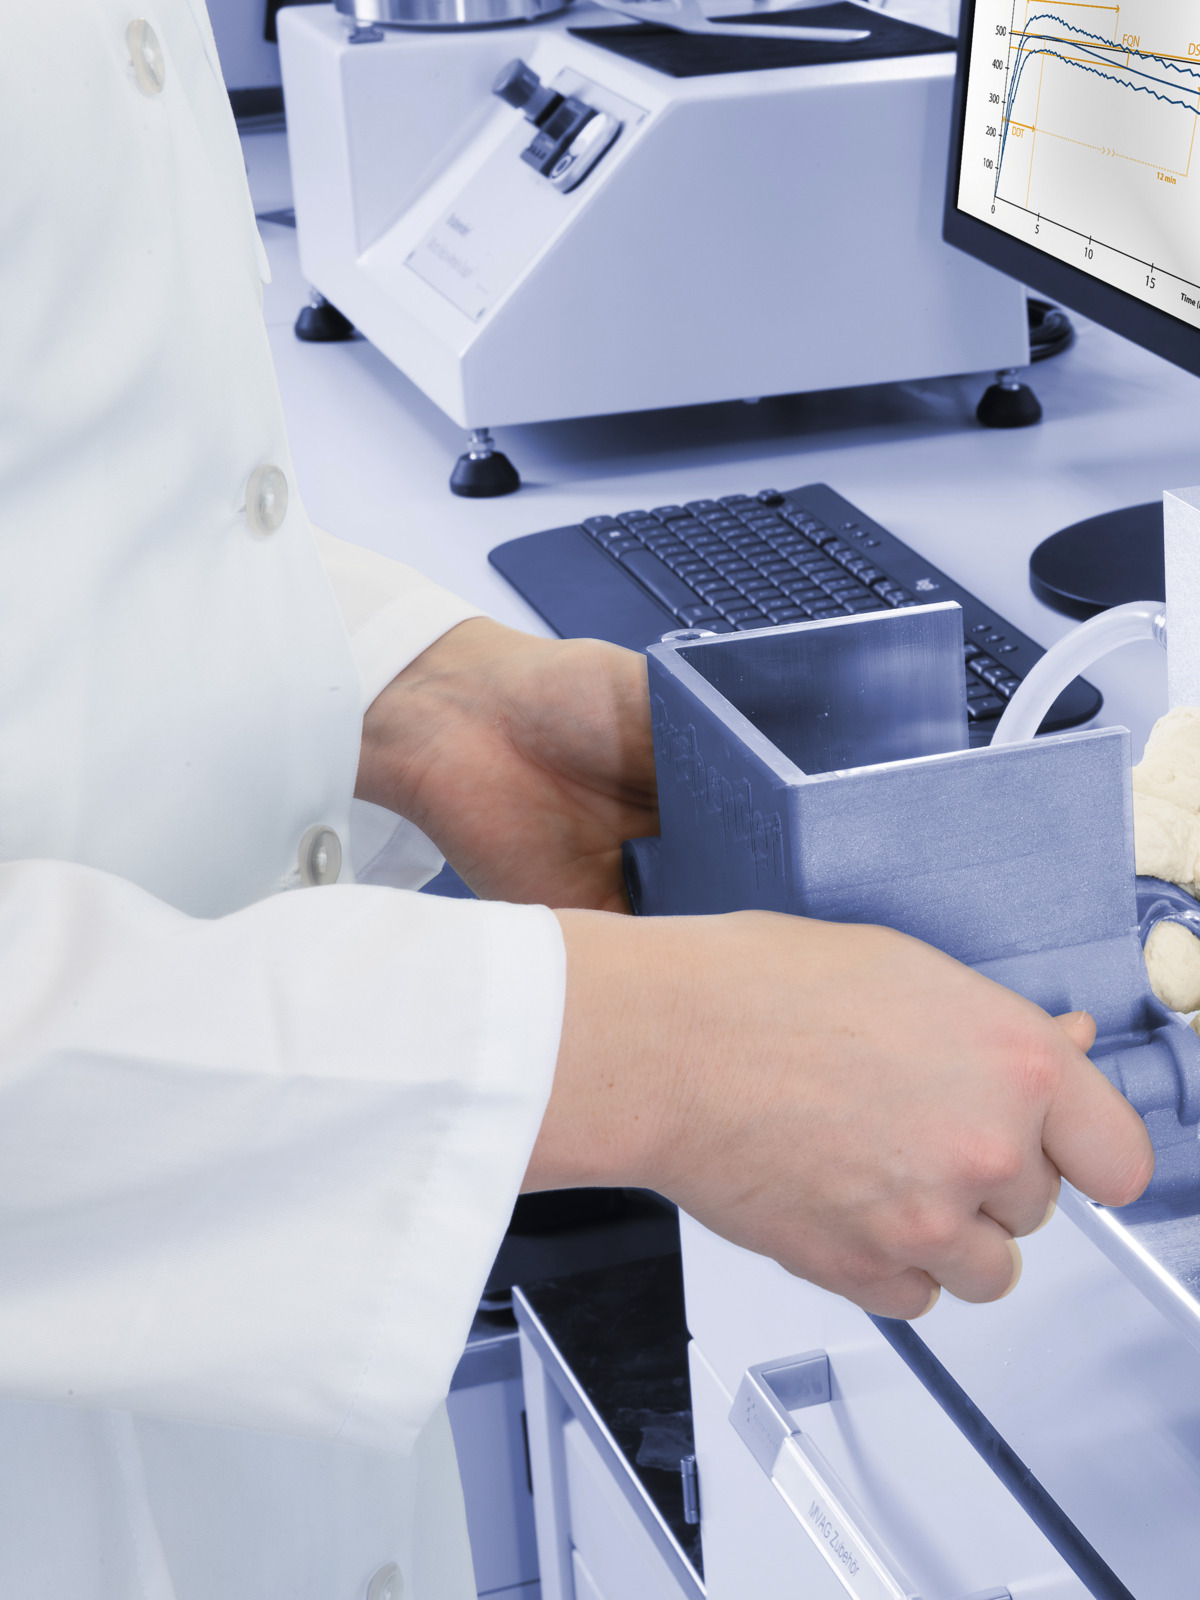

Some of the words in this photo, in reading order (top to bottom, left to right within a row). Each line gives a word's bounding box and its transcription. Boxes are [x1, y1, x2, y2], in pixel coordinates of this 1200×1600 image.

[995, 25, 1007, 37] 500
[1122, 33, 1140, 47] FQN
[1188, 43, 1200, 56] DS
[992, 59, 1003, 70] 400
[988, 93, 1000, 105] 300
[985, 126, 997, 137] 200
[1011, 126, 1025, 139] DDT
[983, 157, 994, 169] 100
[1156, 171, 1164, 181] 12
[1164, 174, 1177, 185] min
[990, 205, 996, 214] 0
[1034, 223, 1040, 235] 5
[1084, 247, 1094, 260] 10
[1145, 275, 1156, 289] 15
[1181, 292, 1196, 307] Time
